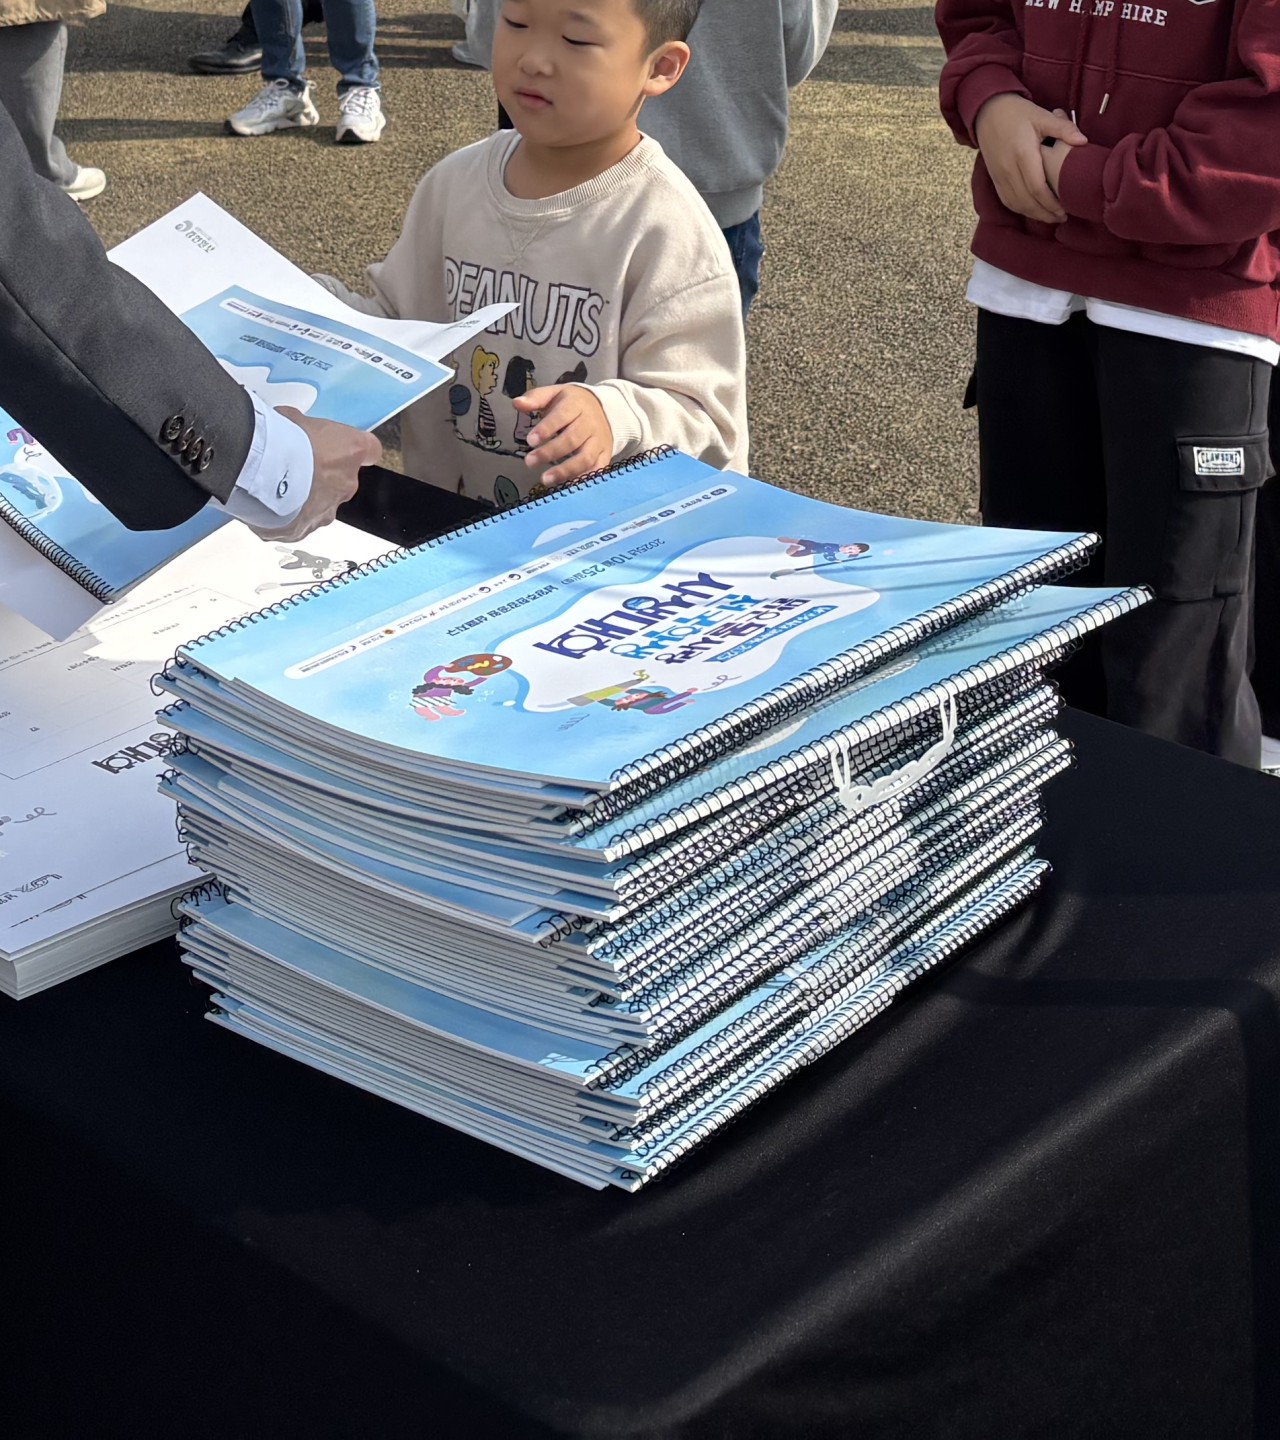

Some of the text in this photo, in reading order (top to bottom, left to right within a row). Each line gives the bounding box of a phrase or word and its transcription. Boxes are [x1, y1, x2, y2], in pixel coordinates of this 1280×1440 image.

[444, 255, 607, 358] PEANUTS
[532, 571, 735, 660] 사생대회
[608, 593, 764, 660] 전국학생
[653, 598, 812, 665] 맑은물사랑
